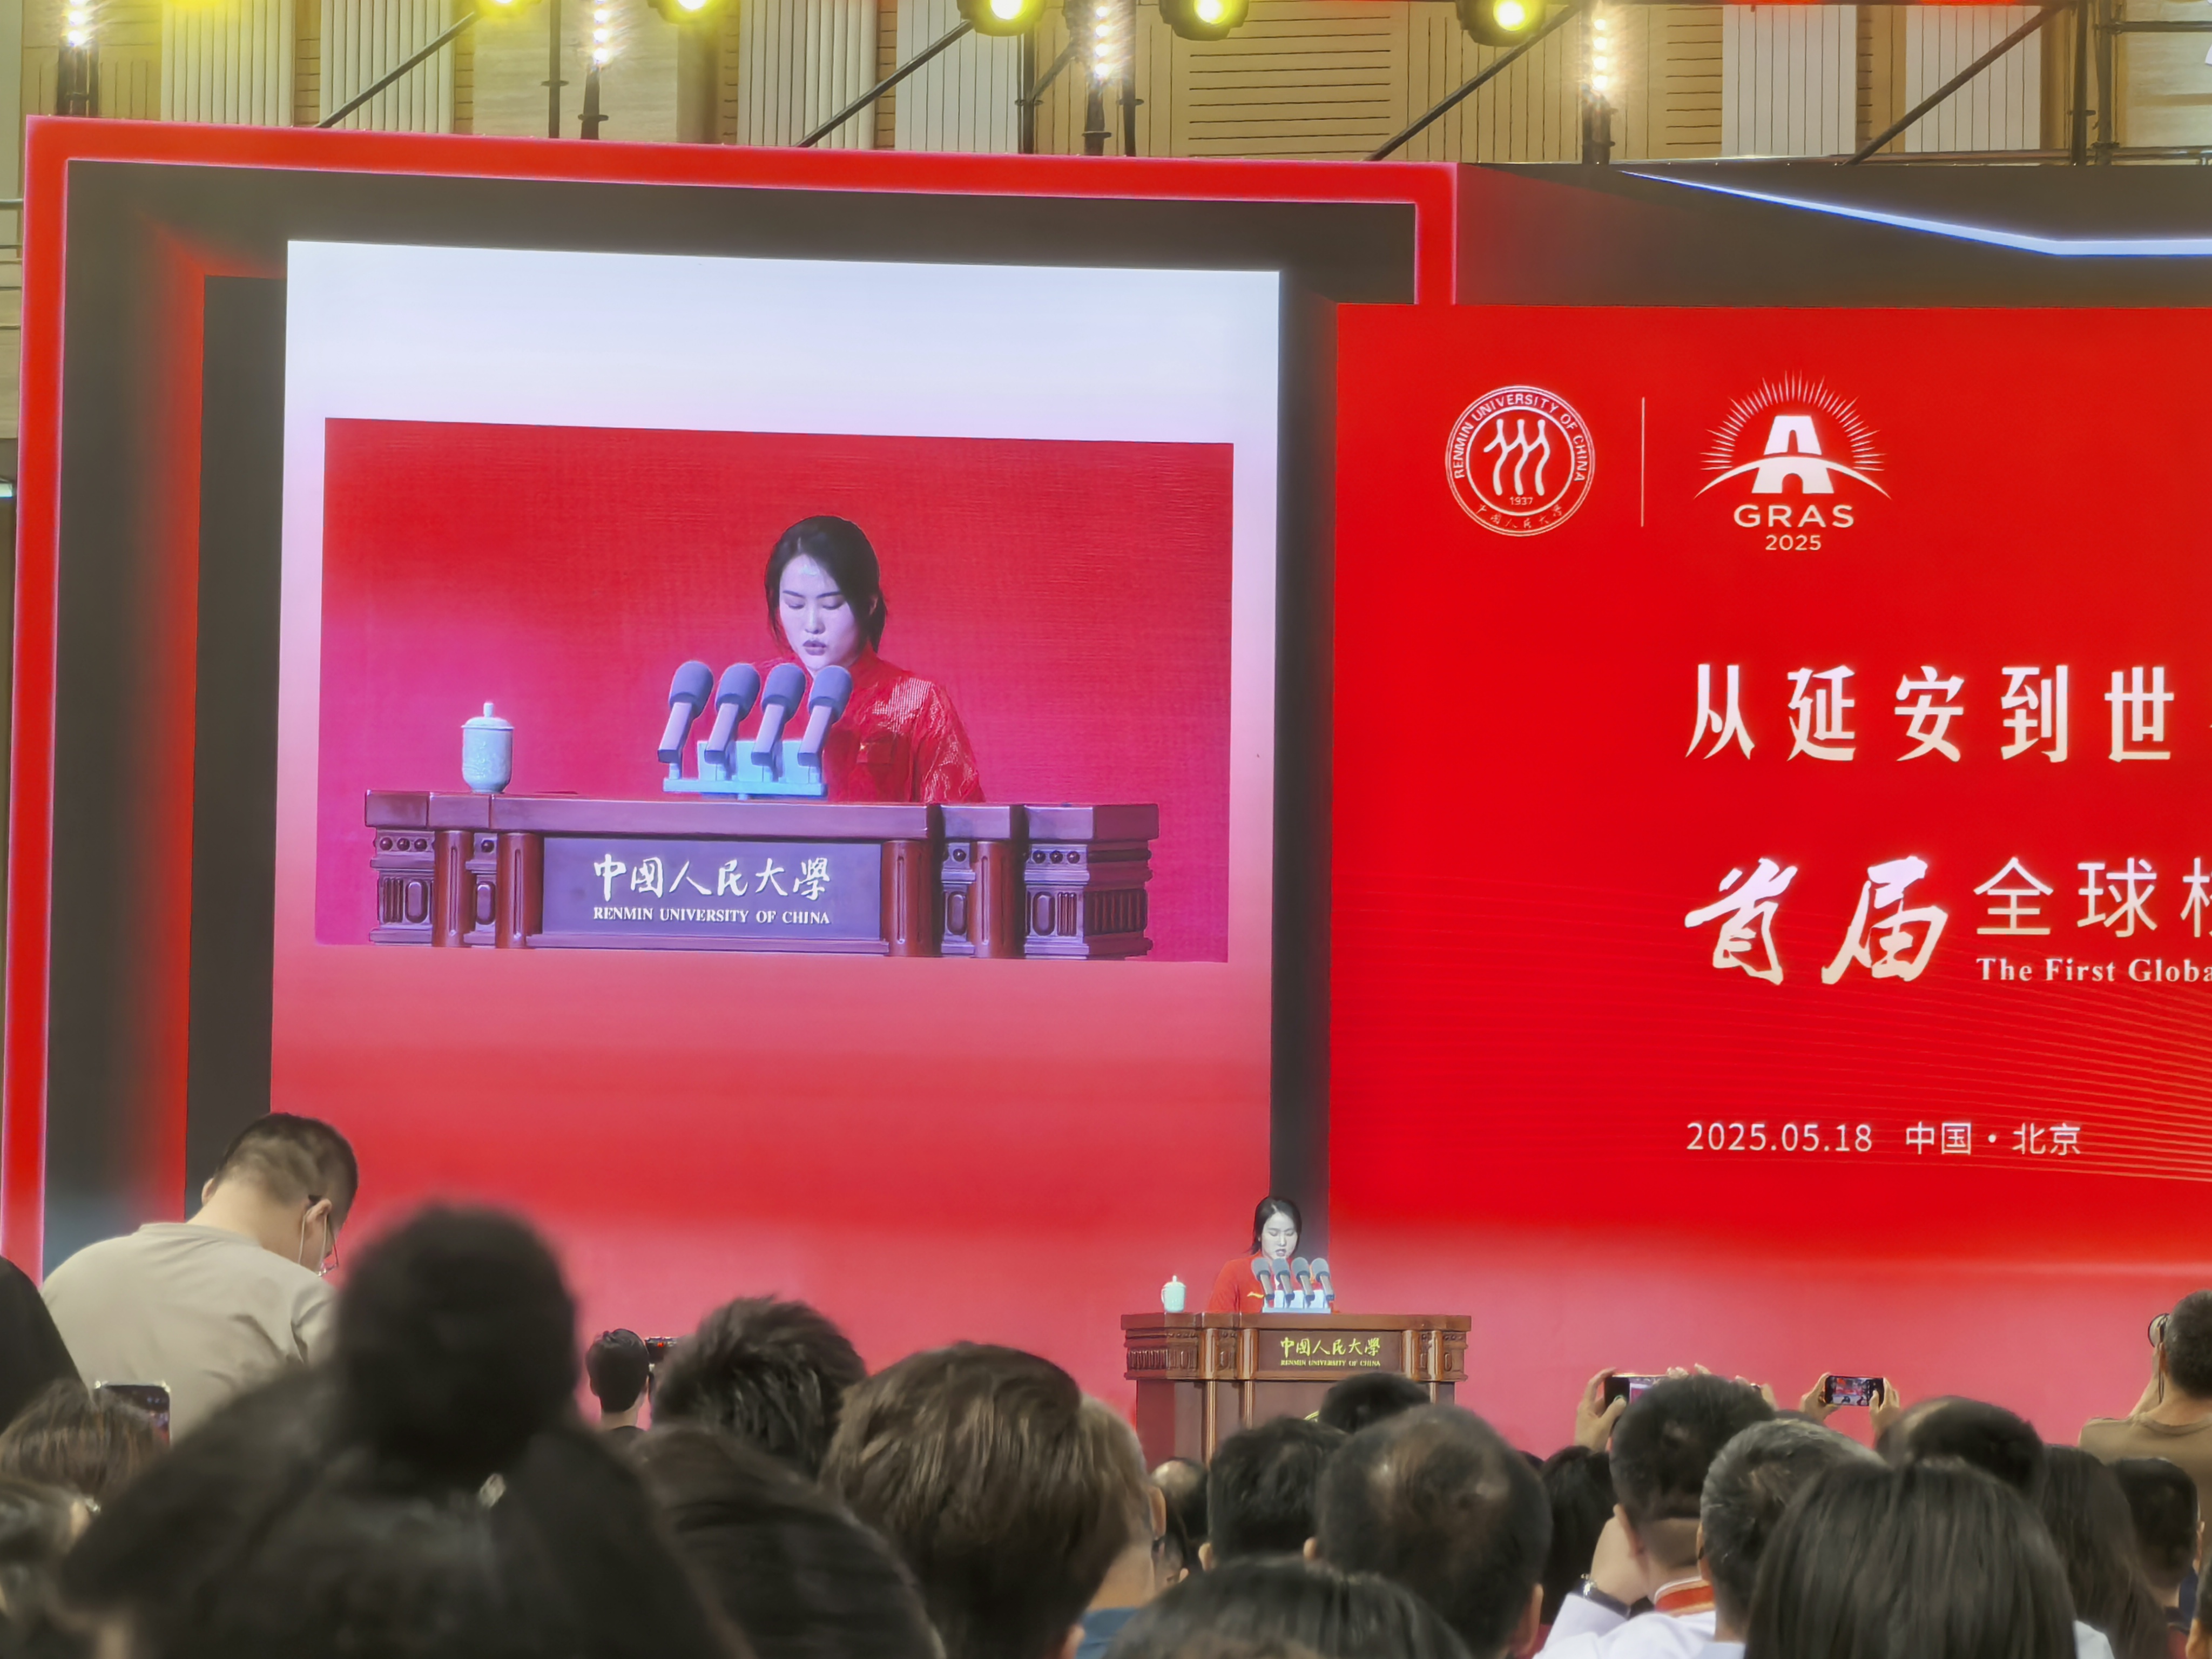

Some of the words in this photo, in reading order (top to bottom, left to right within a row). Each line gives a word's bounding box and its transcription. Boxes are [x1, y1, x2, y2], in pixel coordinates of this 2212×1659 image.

[1453, 422, 1474, 479] RENMIN
[1471, 394, 1559, 421] UNIVERSITY
[1560, 413, 1578, 430] OF
[1573, 435, 1588, 482] CHINA
[1509, 496, 1533, 505] 1937
[1734, 504, 1854, 528] GRAS
[1765, 534, 1821, 551] 2025
[594, 853, 830, 902] 中國人民大學
[594, 907, 653, 920] RENMIN
[659, 908, 749, 923] UNIVERSITY
[756, 911, 777, 923] OF
[782, 911, 830, 924] CHINA
[1684, 855, 1948, 986] 首届
[1976, 957, 2032, 981] The
[2046, 957, 2115, 982] First
[1687, 1122, 1872, 1152] 2025.05.18
